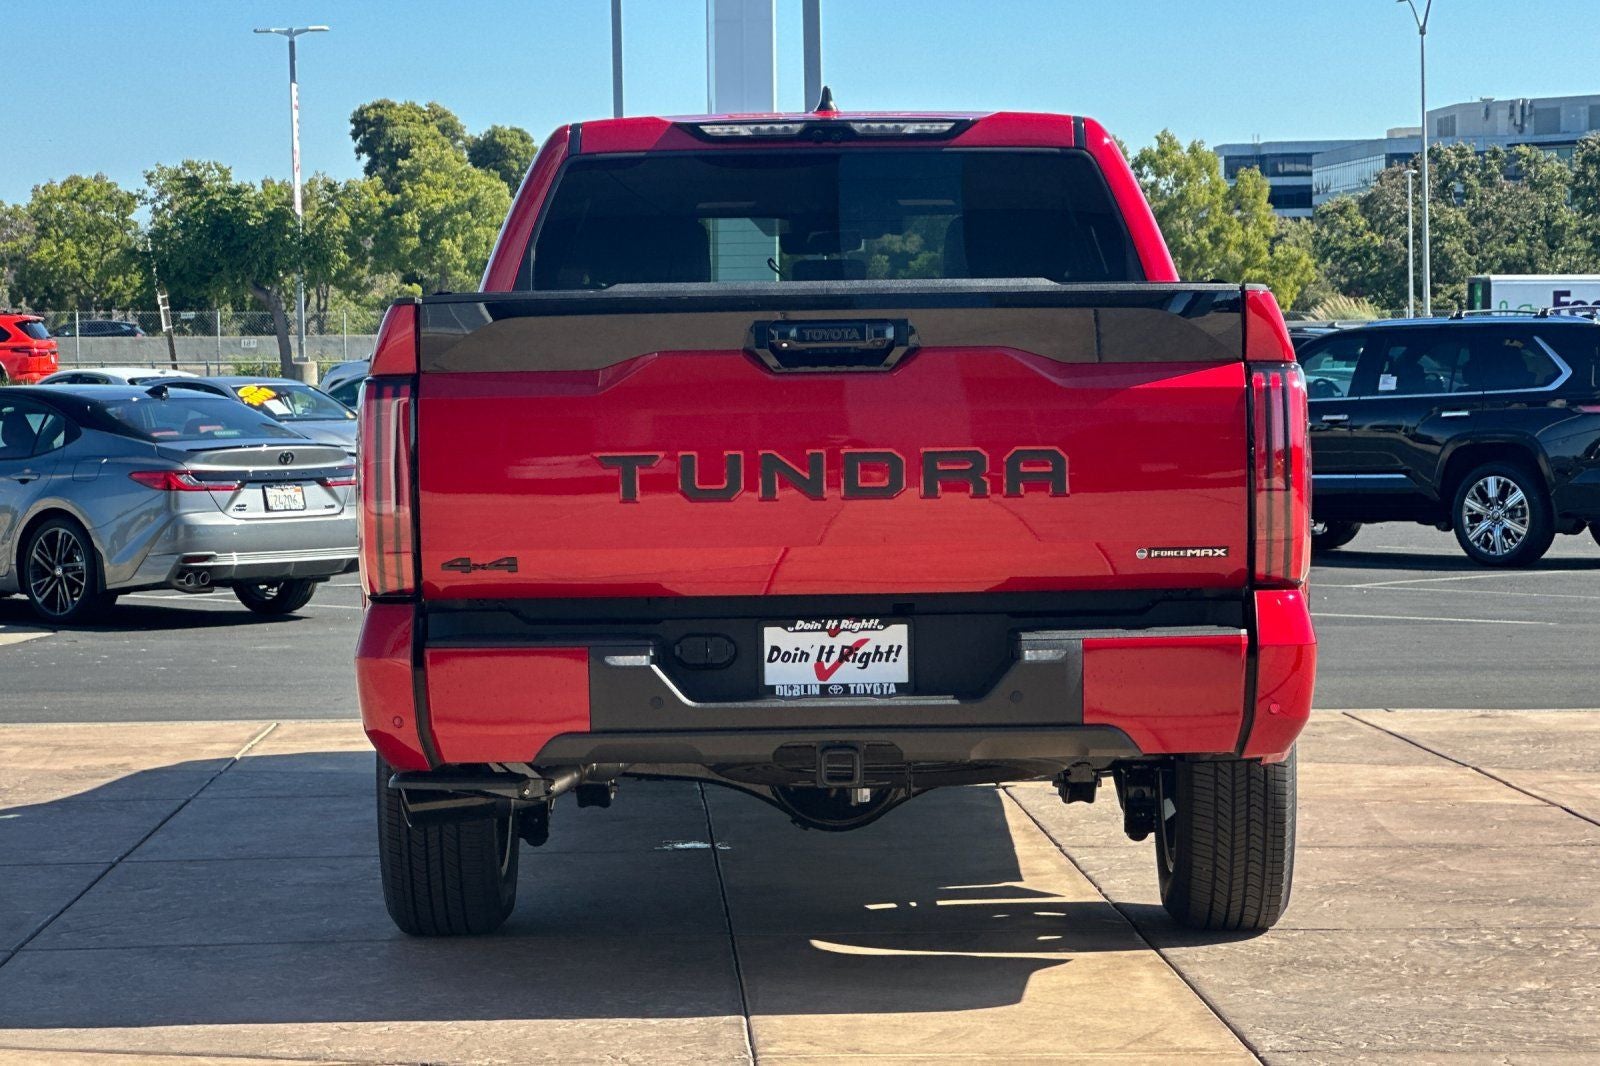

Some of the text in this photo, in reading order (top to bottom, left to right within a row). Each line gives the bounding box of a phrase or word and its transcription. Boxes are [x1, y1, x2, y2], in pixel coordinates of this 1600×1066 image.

[802, 328, 860, 340] TOYOTA
[591, 445, 1071, 503] TUNDRA
[795, 619, 880, 632] Doin' It Right!
[767, 644, 903, 670] Doin' It Right!
[775, 683, 897, 696] DUBLIN TOYOTA
